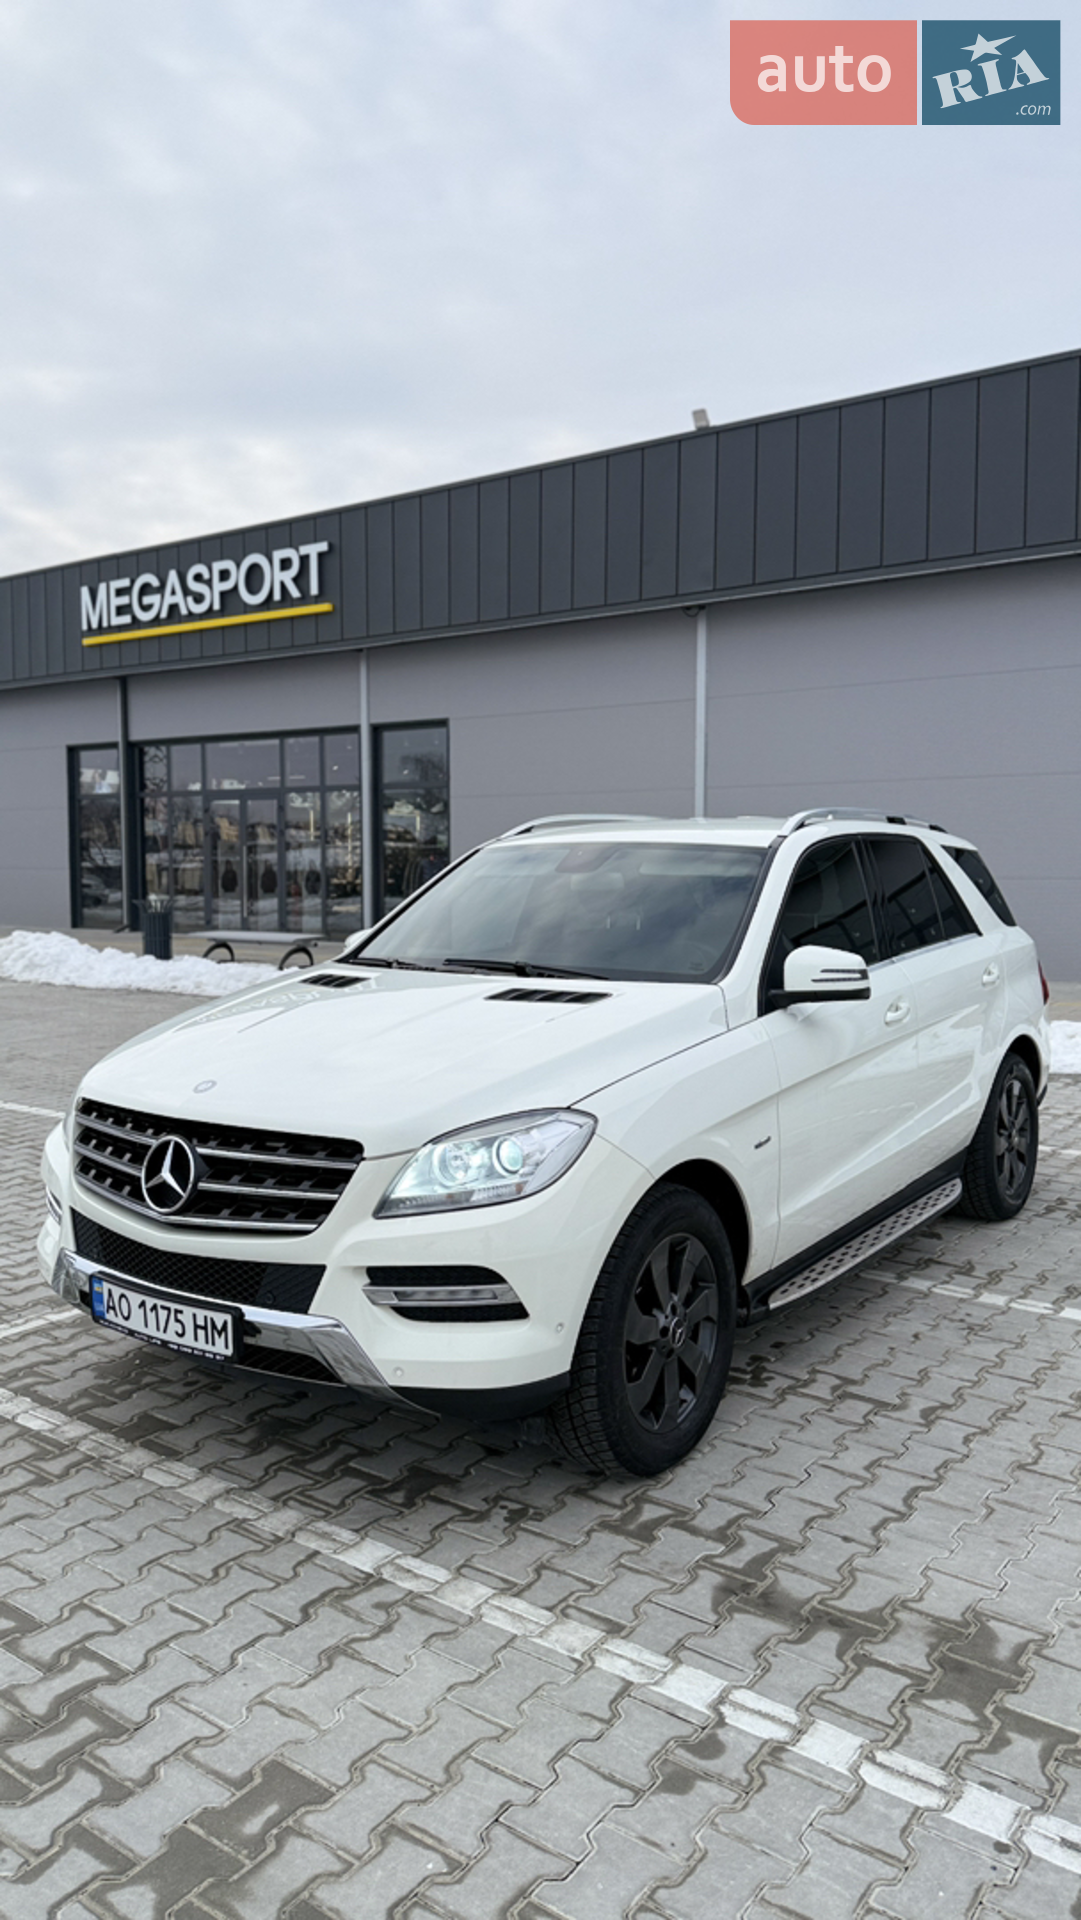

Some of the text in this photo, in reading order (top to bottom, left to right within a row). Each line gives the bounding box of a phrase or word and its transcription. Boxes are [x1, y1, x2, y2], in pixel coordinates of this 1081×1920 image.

[80, 540, 330, 631] MEGASPORT
[105, 1287, 229, 1350] AO 1175 HM
